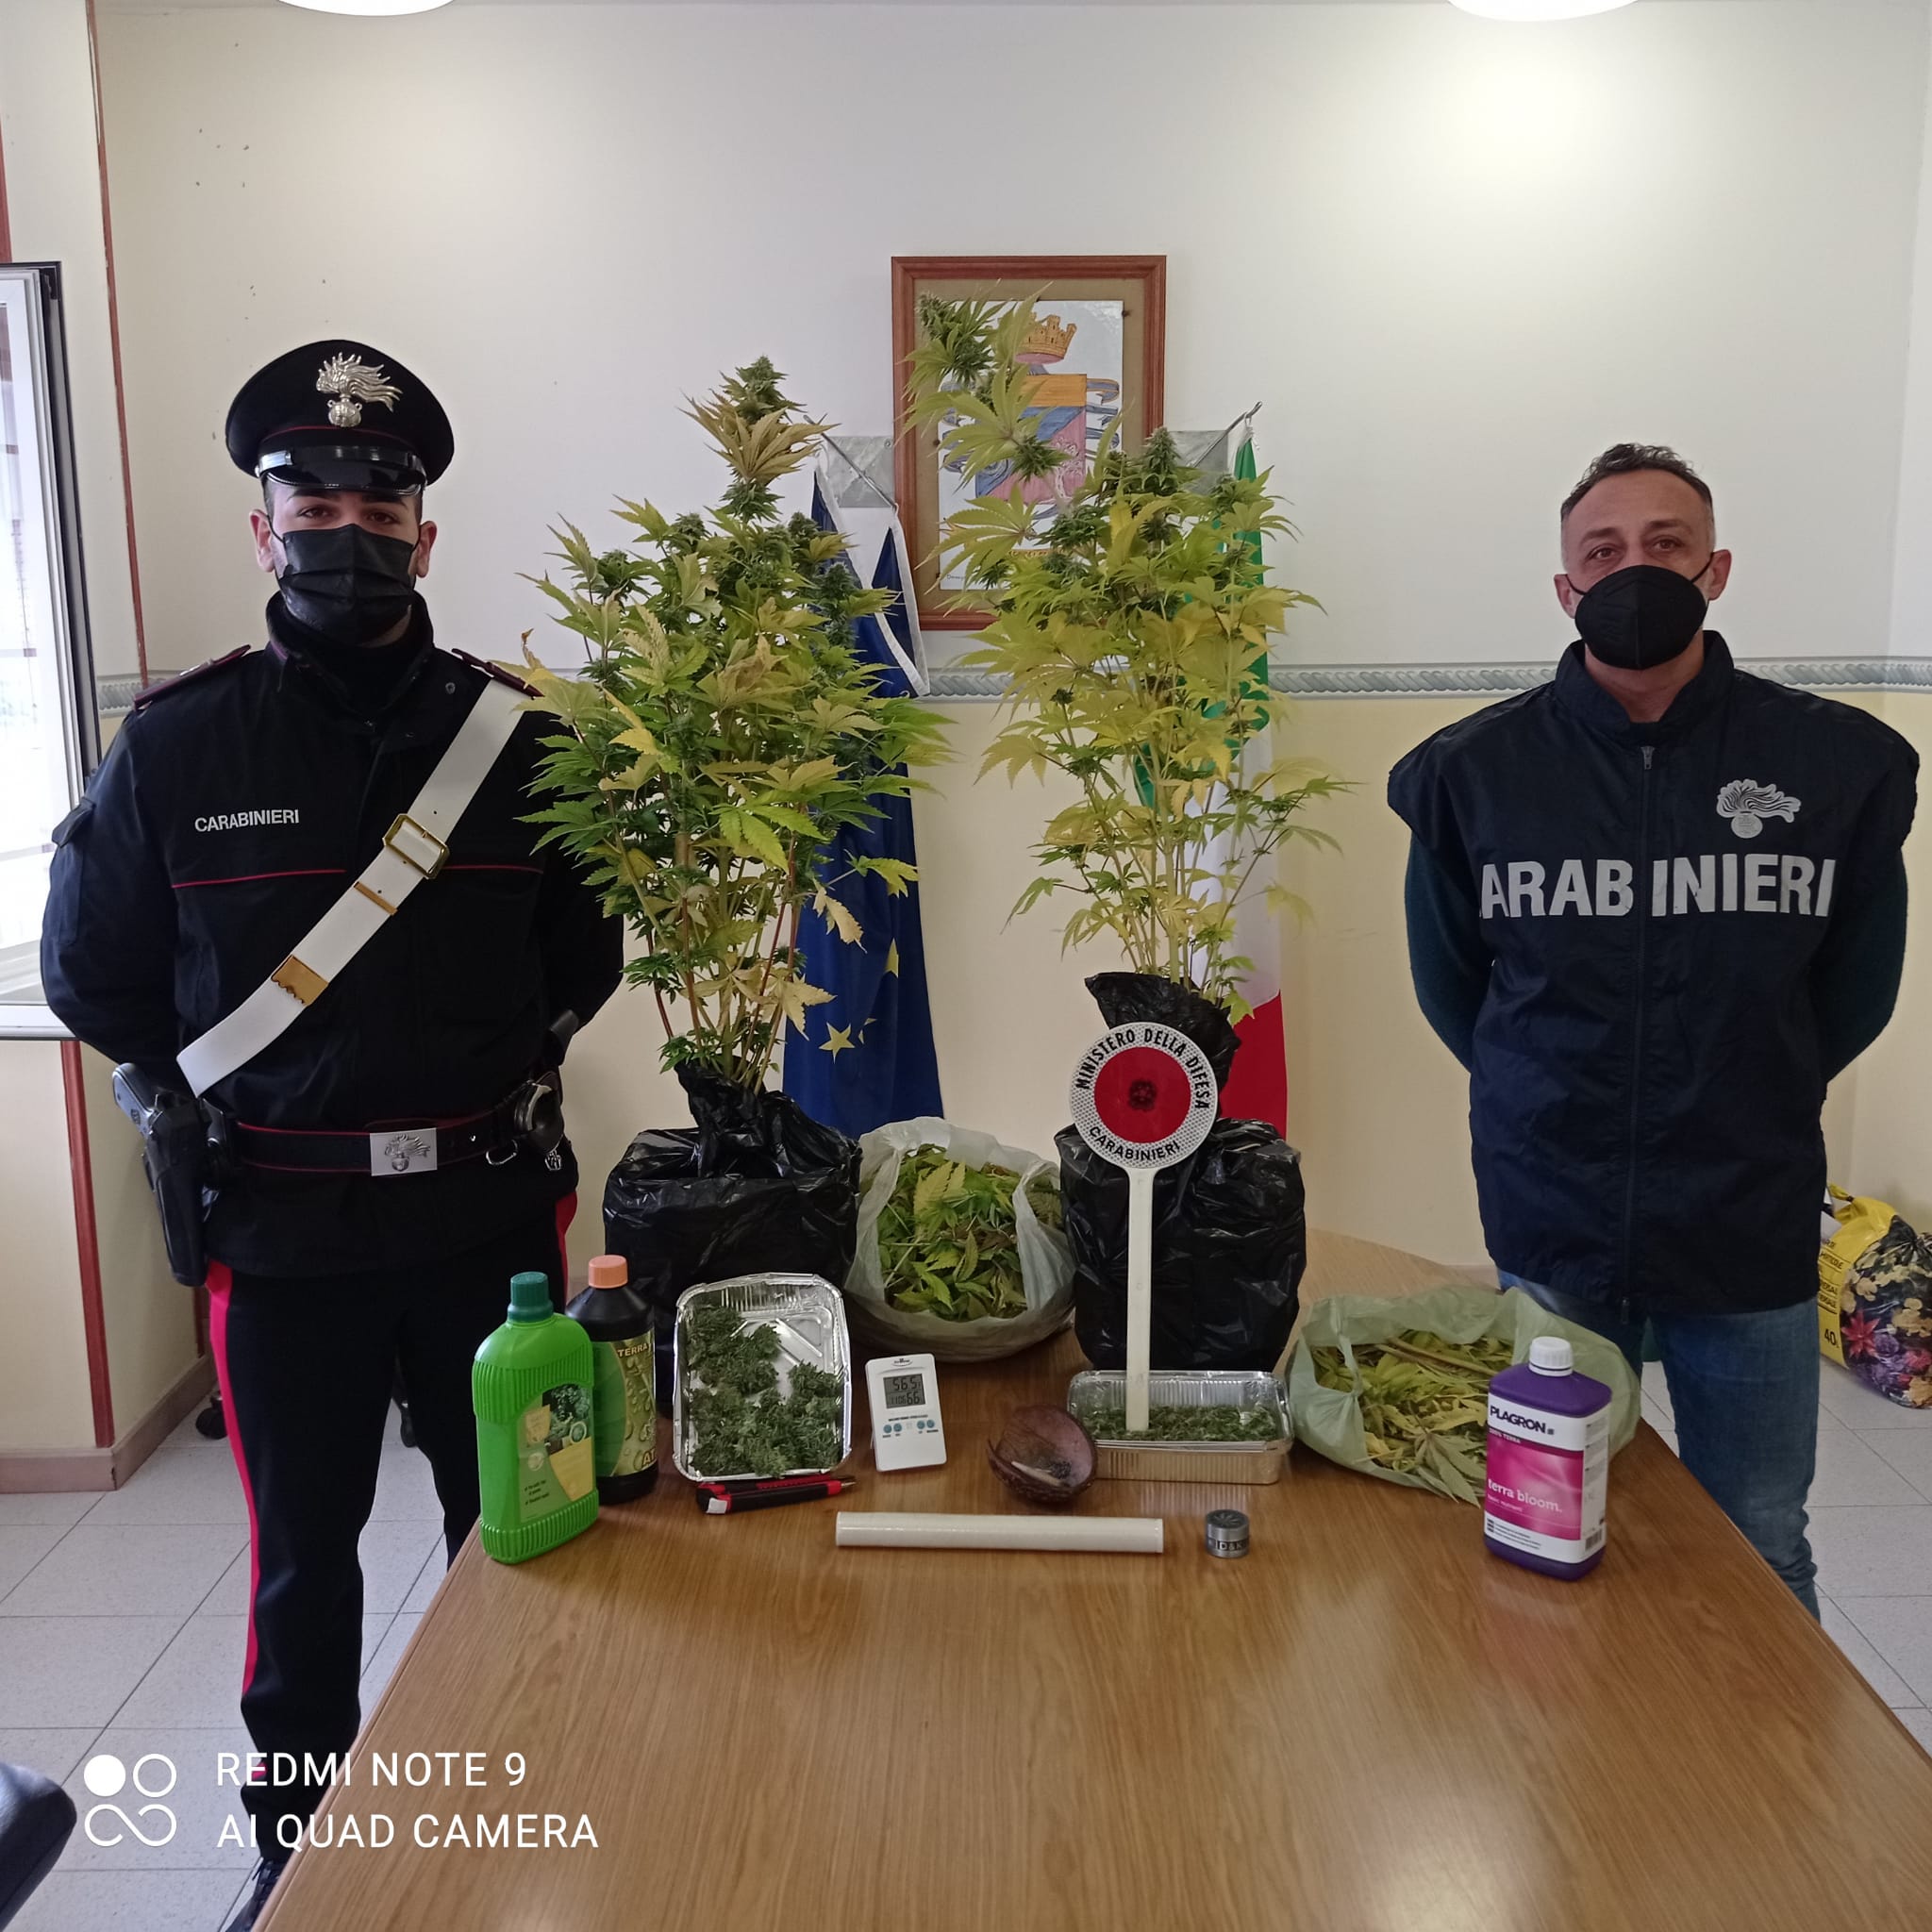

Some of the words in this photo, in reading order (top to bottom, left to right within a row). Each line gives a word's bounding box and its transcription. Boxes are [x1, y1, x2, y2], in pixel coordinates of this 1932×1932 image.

[194, 808, 300, 832] CARABINIERI
[1479, 854, 1836, 919] ARABINIERI
[1075, 1028, 1135, 1090] MINISTERO
[1144, 1027, 1187, 1058] DELLA
[1185, 1056, 1210, 1109] DIFESA
[1090, 1126, 1180, 1161] CARABINIERI
[617, 1342, 649, 1357] TERRA
[1824, 1328, 1837, 1345] 40
[1490, 1406, 1546, 1434] PLAGRON
[1488, 1478, 1514, 1498] terra
